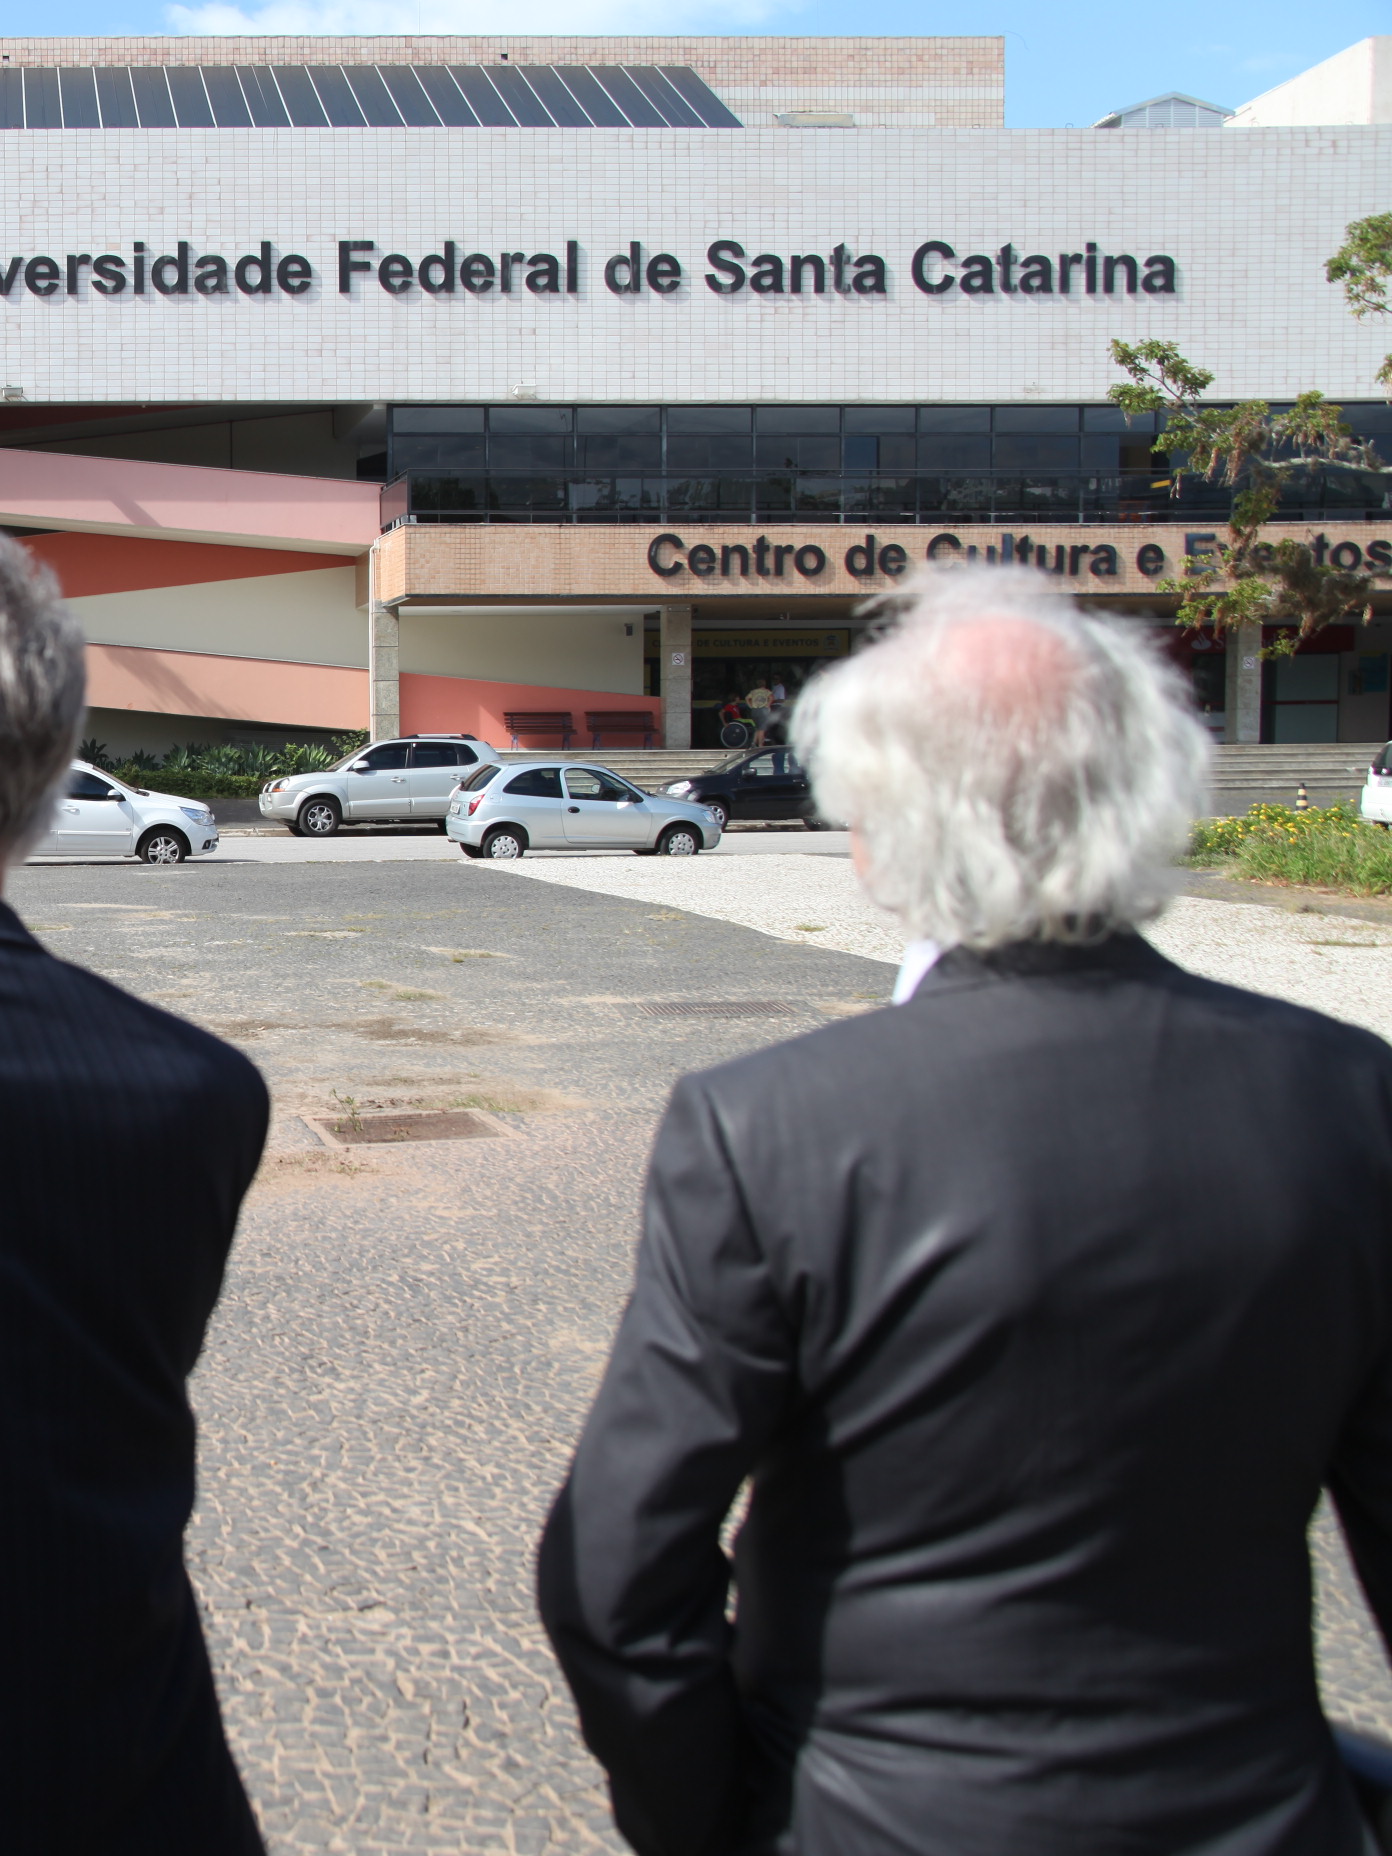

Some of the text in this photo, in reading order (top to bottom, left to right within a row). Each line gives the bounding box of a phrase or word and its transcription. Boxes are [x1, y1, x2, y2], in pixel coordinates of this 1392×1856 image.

[338, 240, 579, 295] Federal
[604, 241, 682, 295] de
[704, 239, 887, 295] Santa
[911, 240, 1176, 295] Catarina
[647, 533, 827, 579] Centro
[844, 533, 907, 579] de
[1136, 543, 1165, 578] e
[1184, 532, 1392, 577] Evetos
